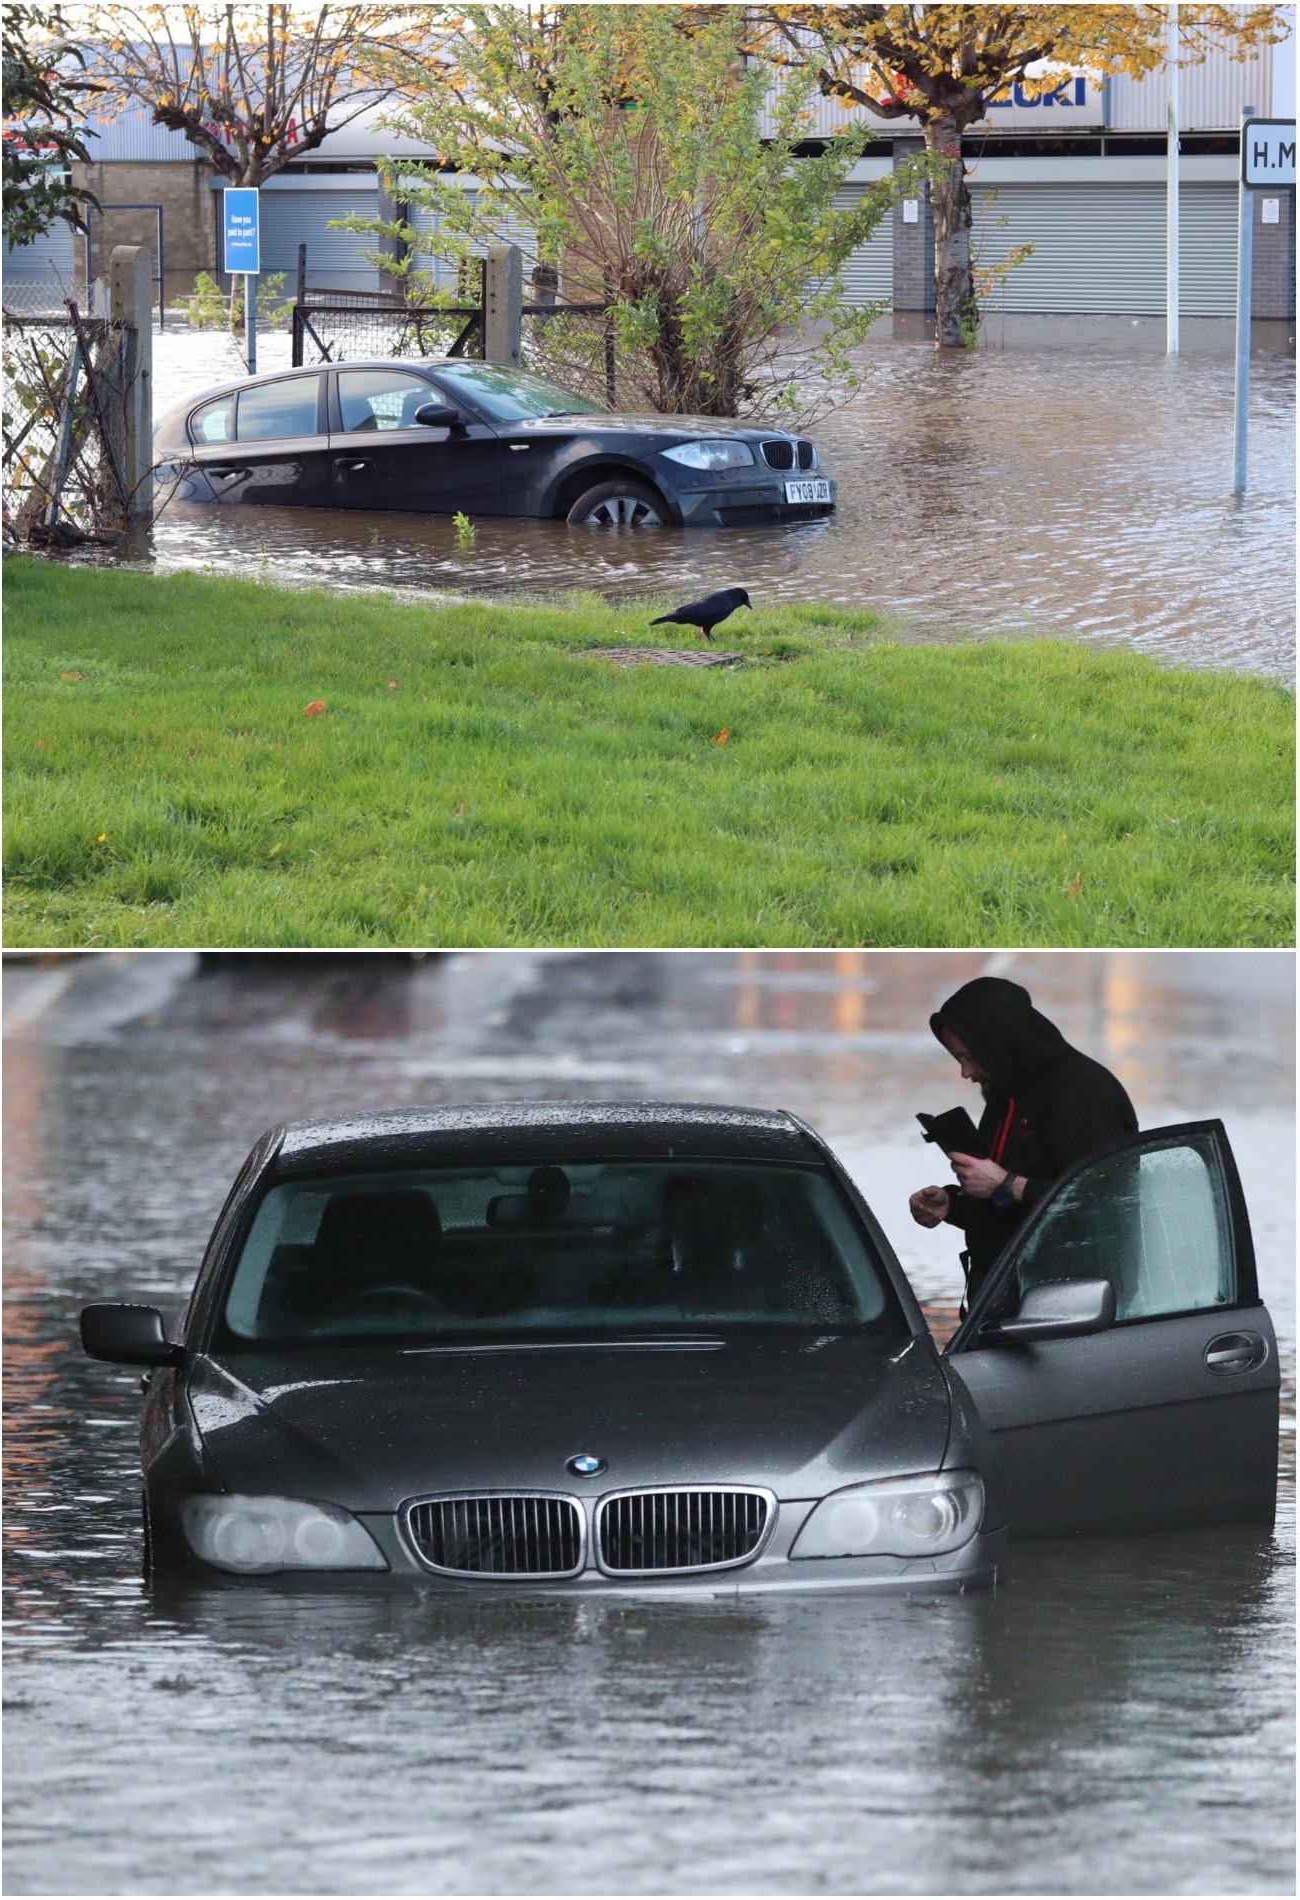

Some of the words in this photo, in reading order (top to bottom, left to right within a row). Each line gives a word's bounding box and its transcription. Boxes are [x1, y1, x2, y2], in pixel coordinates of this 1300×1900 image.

[242, 216, 252, 225] you
[227, 227, 237, 238] paid
[242, 227, 256, 238] park?
[790, 483, 814, 500] FY08
